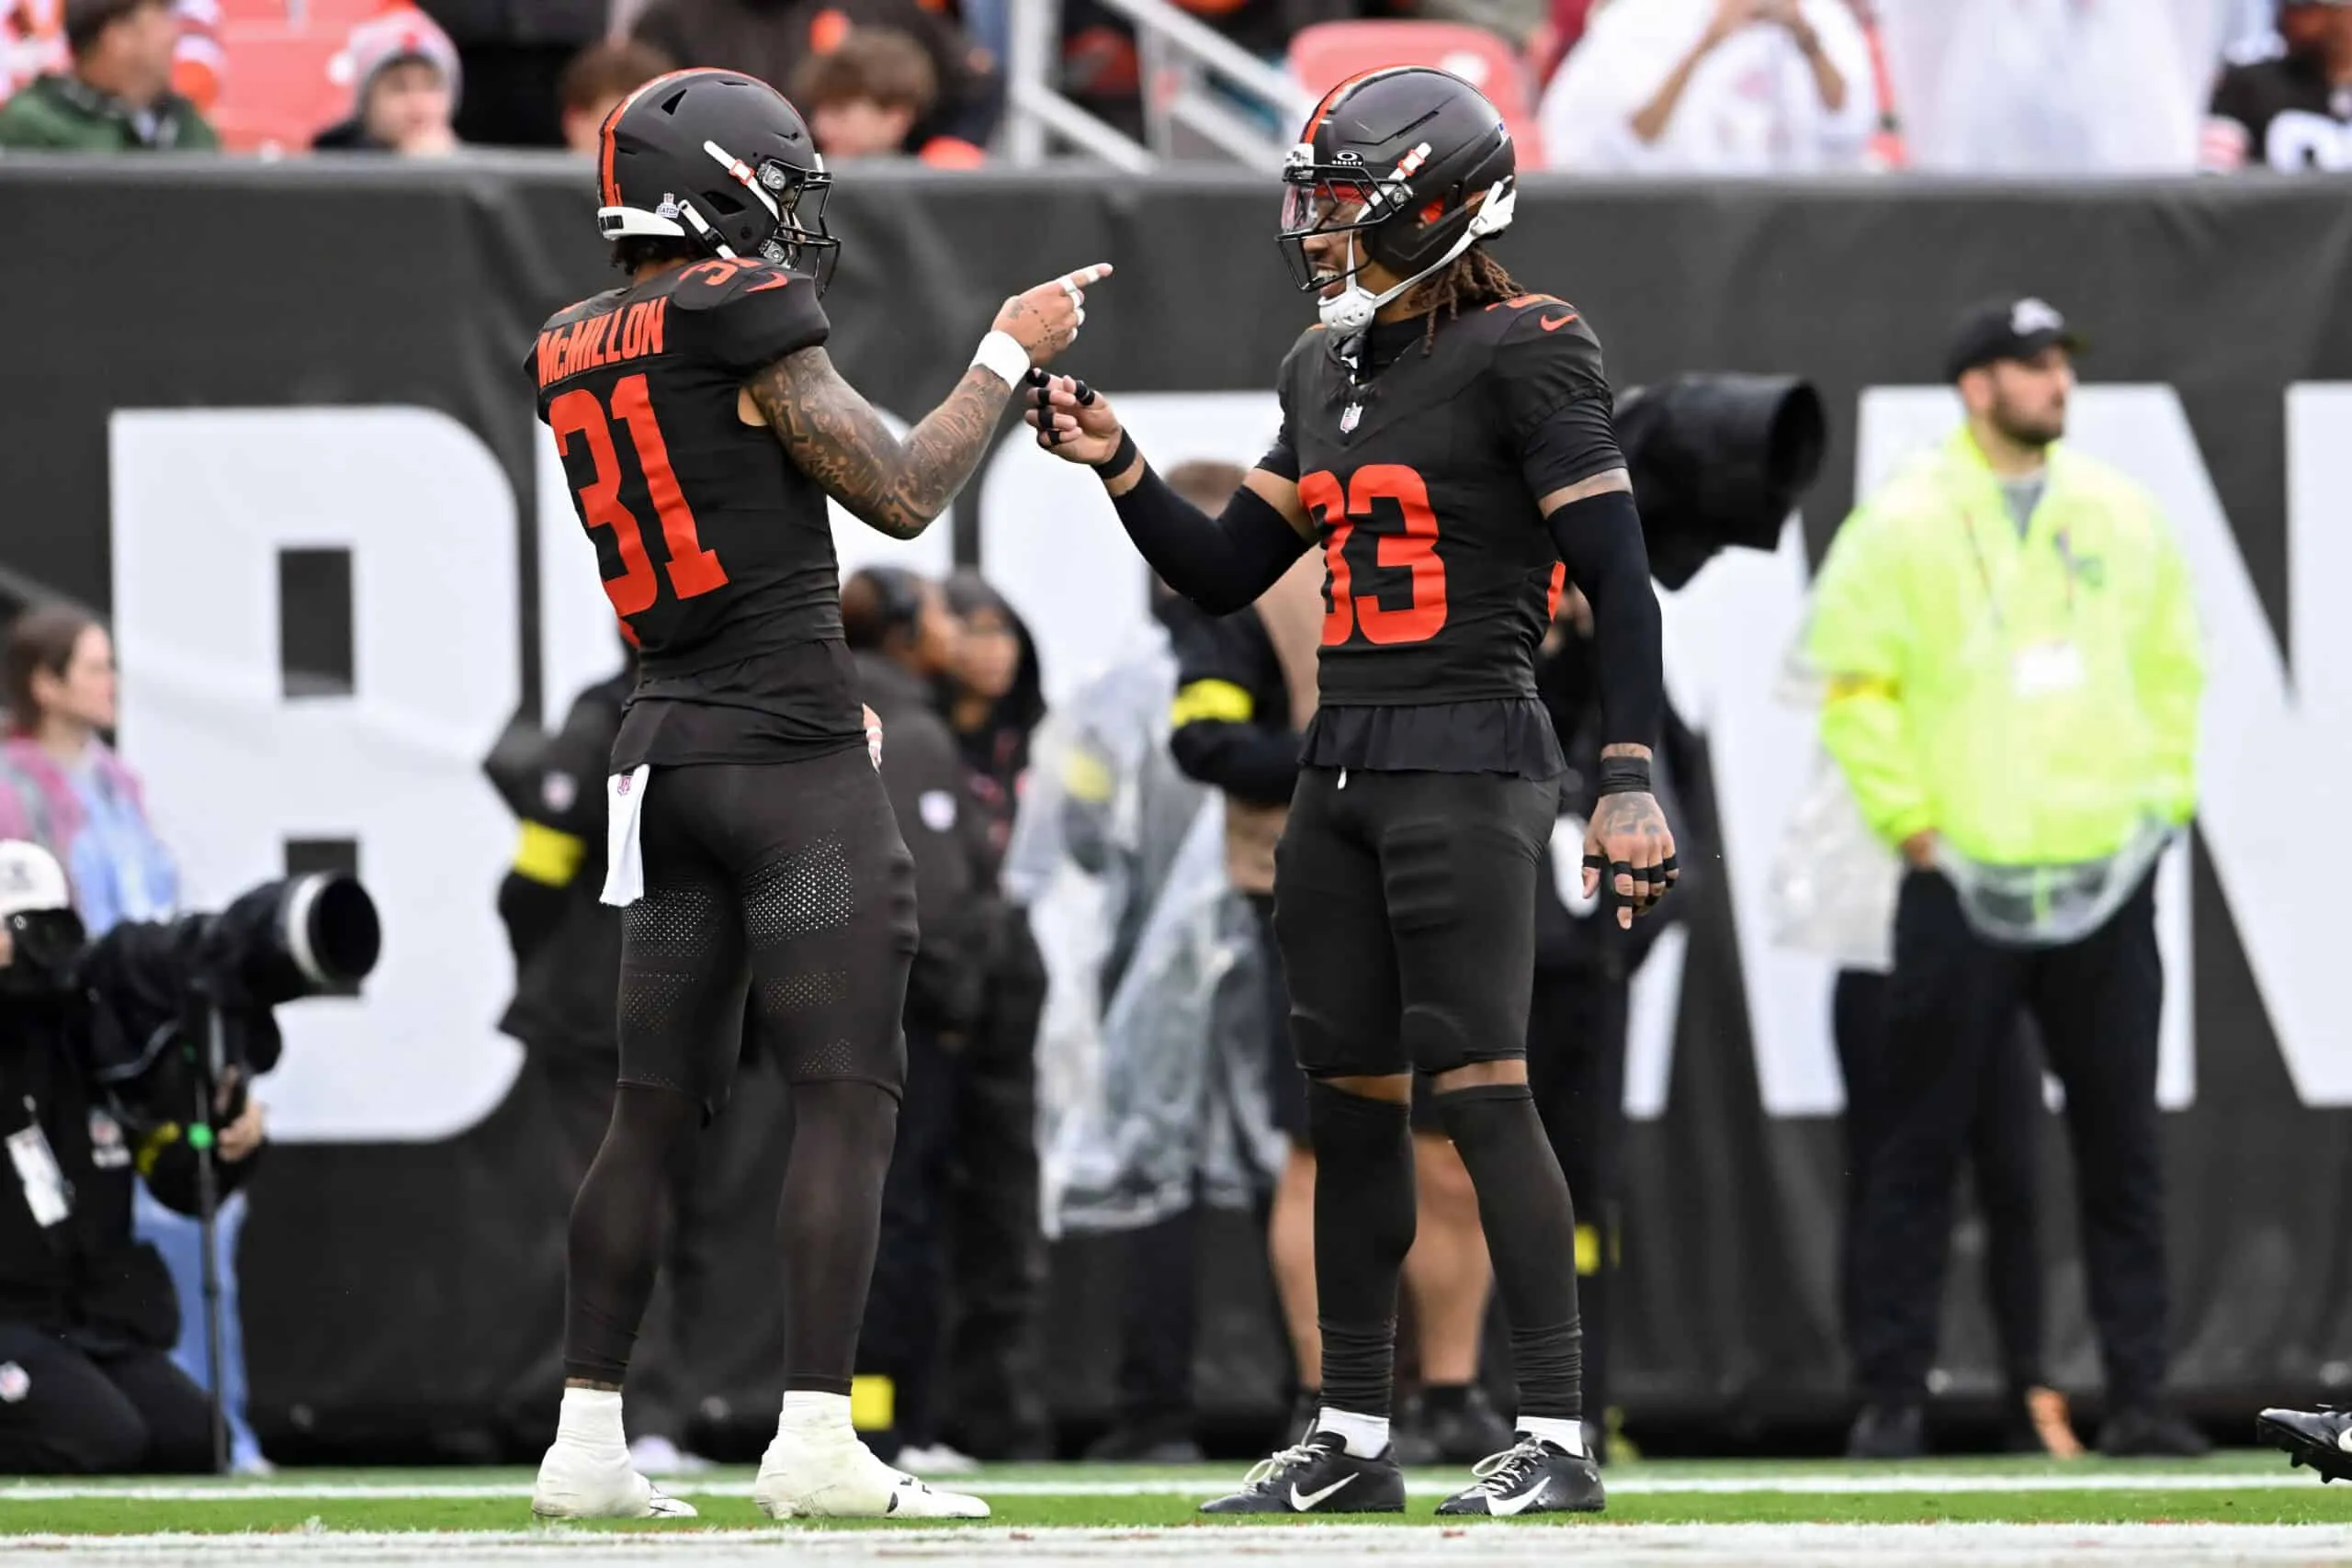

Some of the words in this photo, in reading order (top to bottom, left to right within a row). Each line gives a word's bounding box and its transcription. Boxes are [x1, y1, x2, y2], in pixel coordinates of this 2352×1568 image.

[537, 296, 668, 389] McMILLON
[549, 373, 729, 616] 31
[1297, 464, 1448, 646] 33
